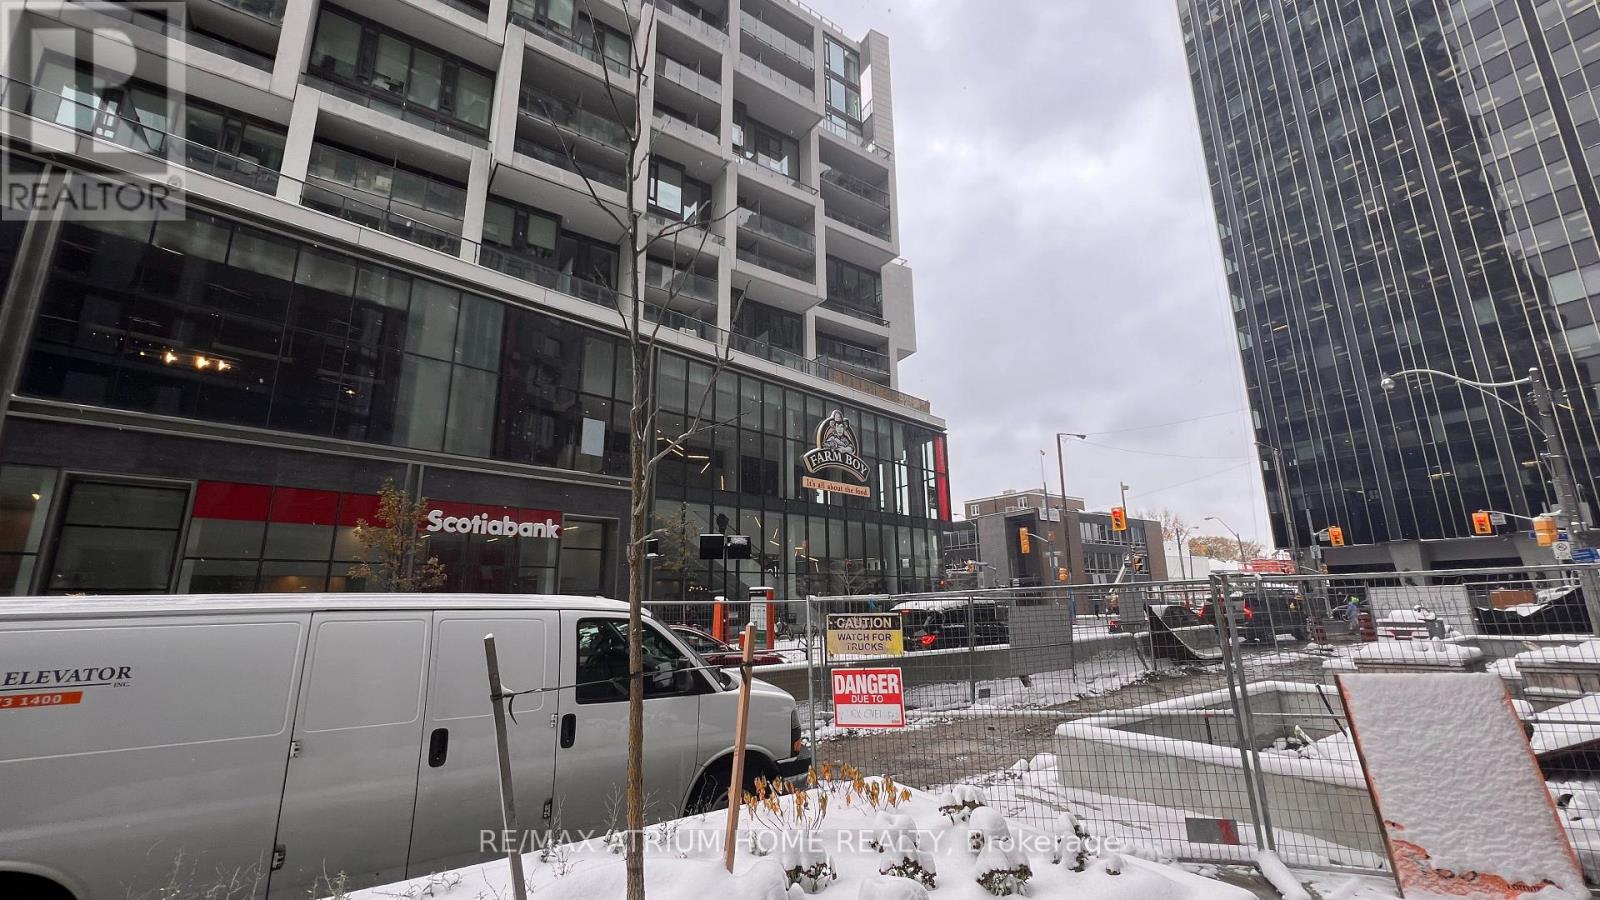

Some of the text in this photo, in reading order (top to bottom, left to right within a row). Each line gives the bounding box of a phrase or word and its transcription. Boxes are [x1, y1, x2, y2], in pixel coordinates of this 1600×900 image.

[810, 451, 868, 474] FARM BOY
[426, 509, 560, 539] Scotiabank
[836, 617, 892, 629] CAUTION
[837, 633, 892, 641] WATCH FOR
[847, 642, 884, 651] TRUCKS
[2, 666, 132, 686] ELEVATOR
[834, 673, 900, 695] DANGER
[20, 694, 62, 706] 1400
[851, 694, 884, 703] DUE TO
